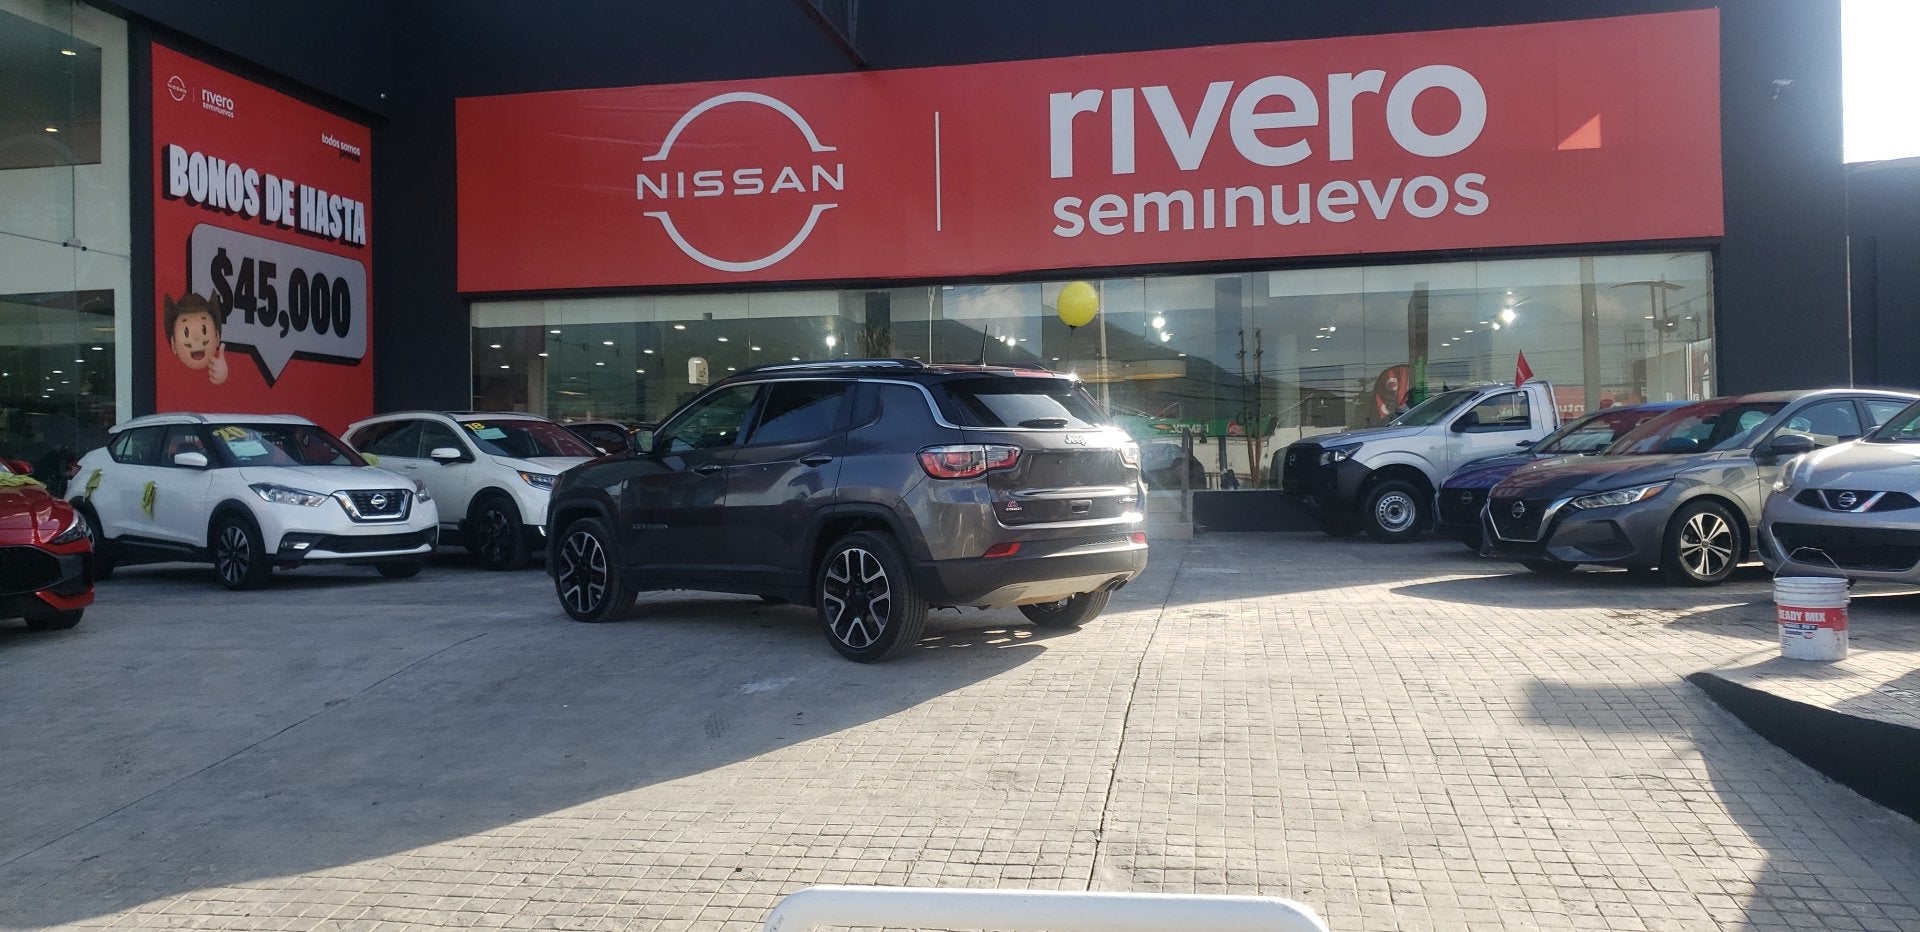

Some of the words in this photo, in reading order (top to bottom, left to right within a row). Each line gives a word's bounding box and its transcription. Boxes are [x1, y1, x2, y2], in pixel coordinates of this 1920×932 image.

[202, 89, 234, 111] rivero
[1050, 64, 1487, 178] rivero
[321, 133, 340, 149] todos
[340, 141, 361, 156] somos
[167, 143, 260, 218] BONOS
[264, 173, 295, 226] DE
[299, 184, 366, 246] HASTA
[636, 163, 844, 200] NISSAN
[1053, 173, 1489, 237] seminuevos
[210, 247, 351, 339] $45,000
[1805, 612, 1826, 622] MIX
